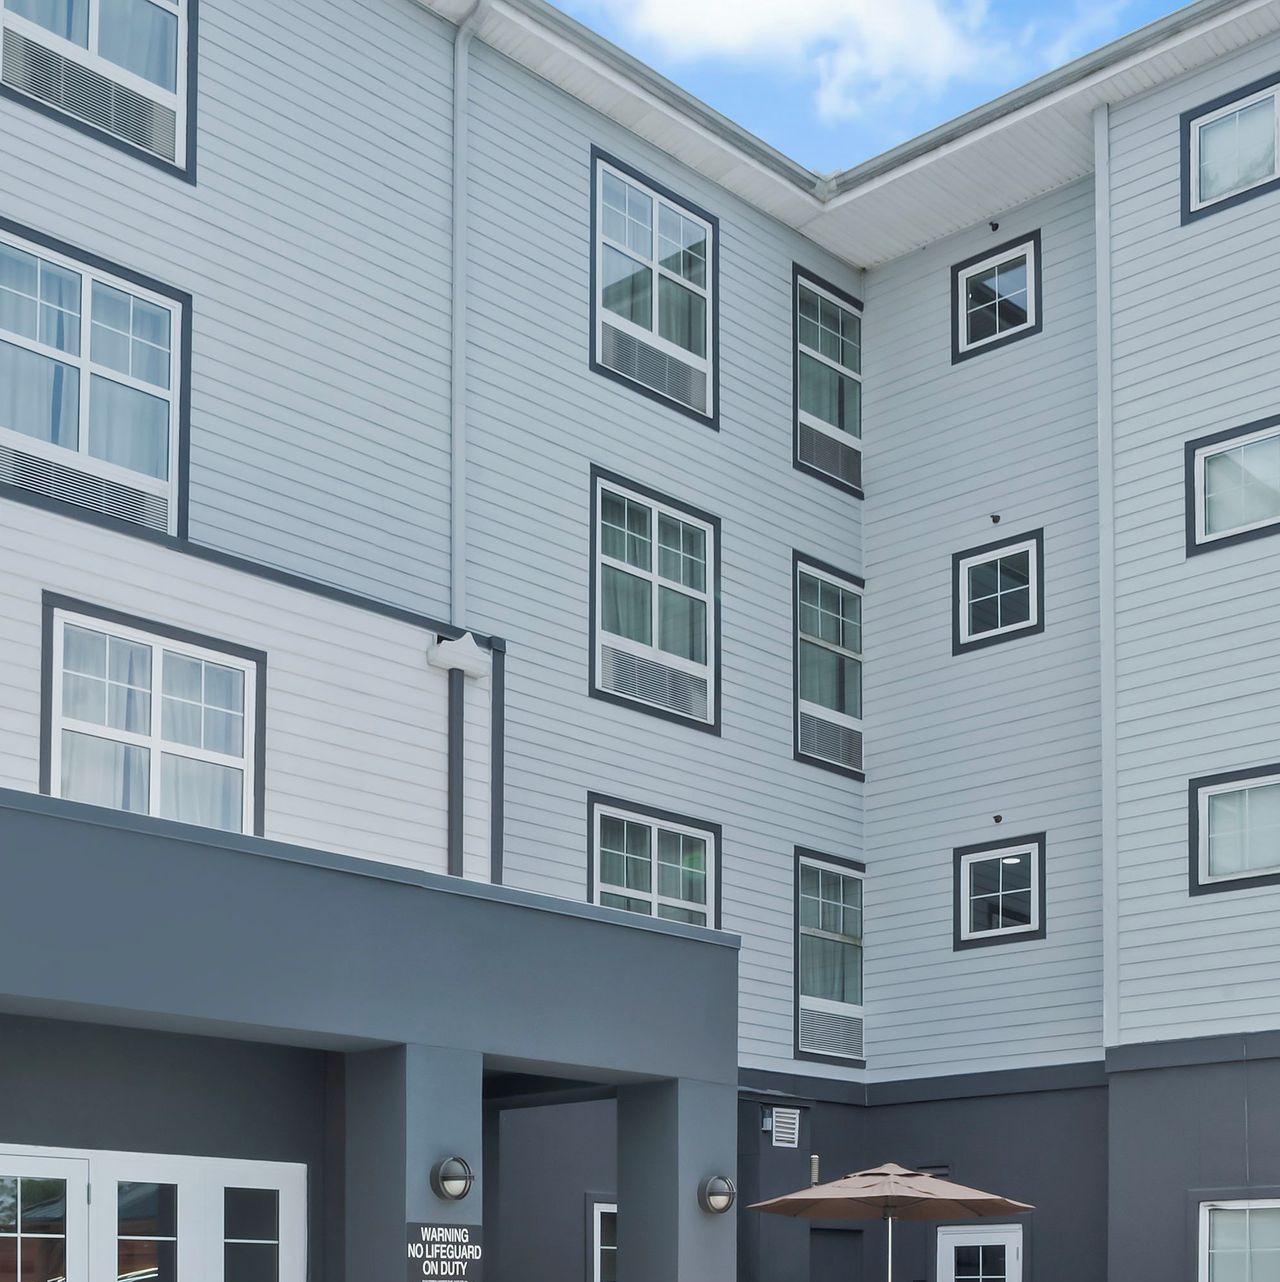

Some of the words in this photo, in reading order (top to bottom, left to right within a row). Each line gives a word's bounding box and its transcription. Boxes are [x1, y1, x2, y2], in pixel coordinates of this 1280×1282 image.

[420, 1227, 469, 1243] WARNING
[407, 1243, 424, 1259] NO
[425, 1244, 482, 1260] LIFEGUARD
[422, 1260, 439, 1276] ON
[440, 1261, 468, 1276] DUTY
